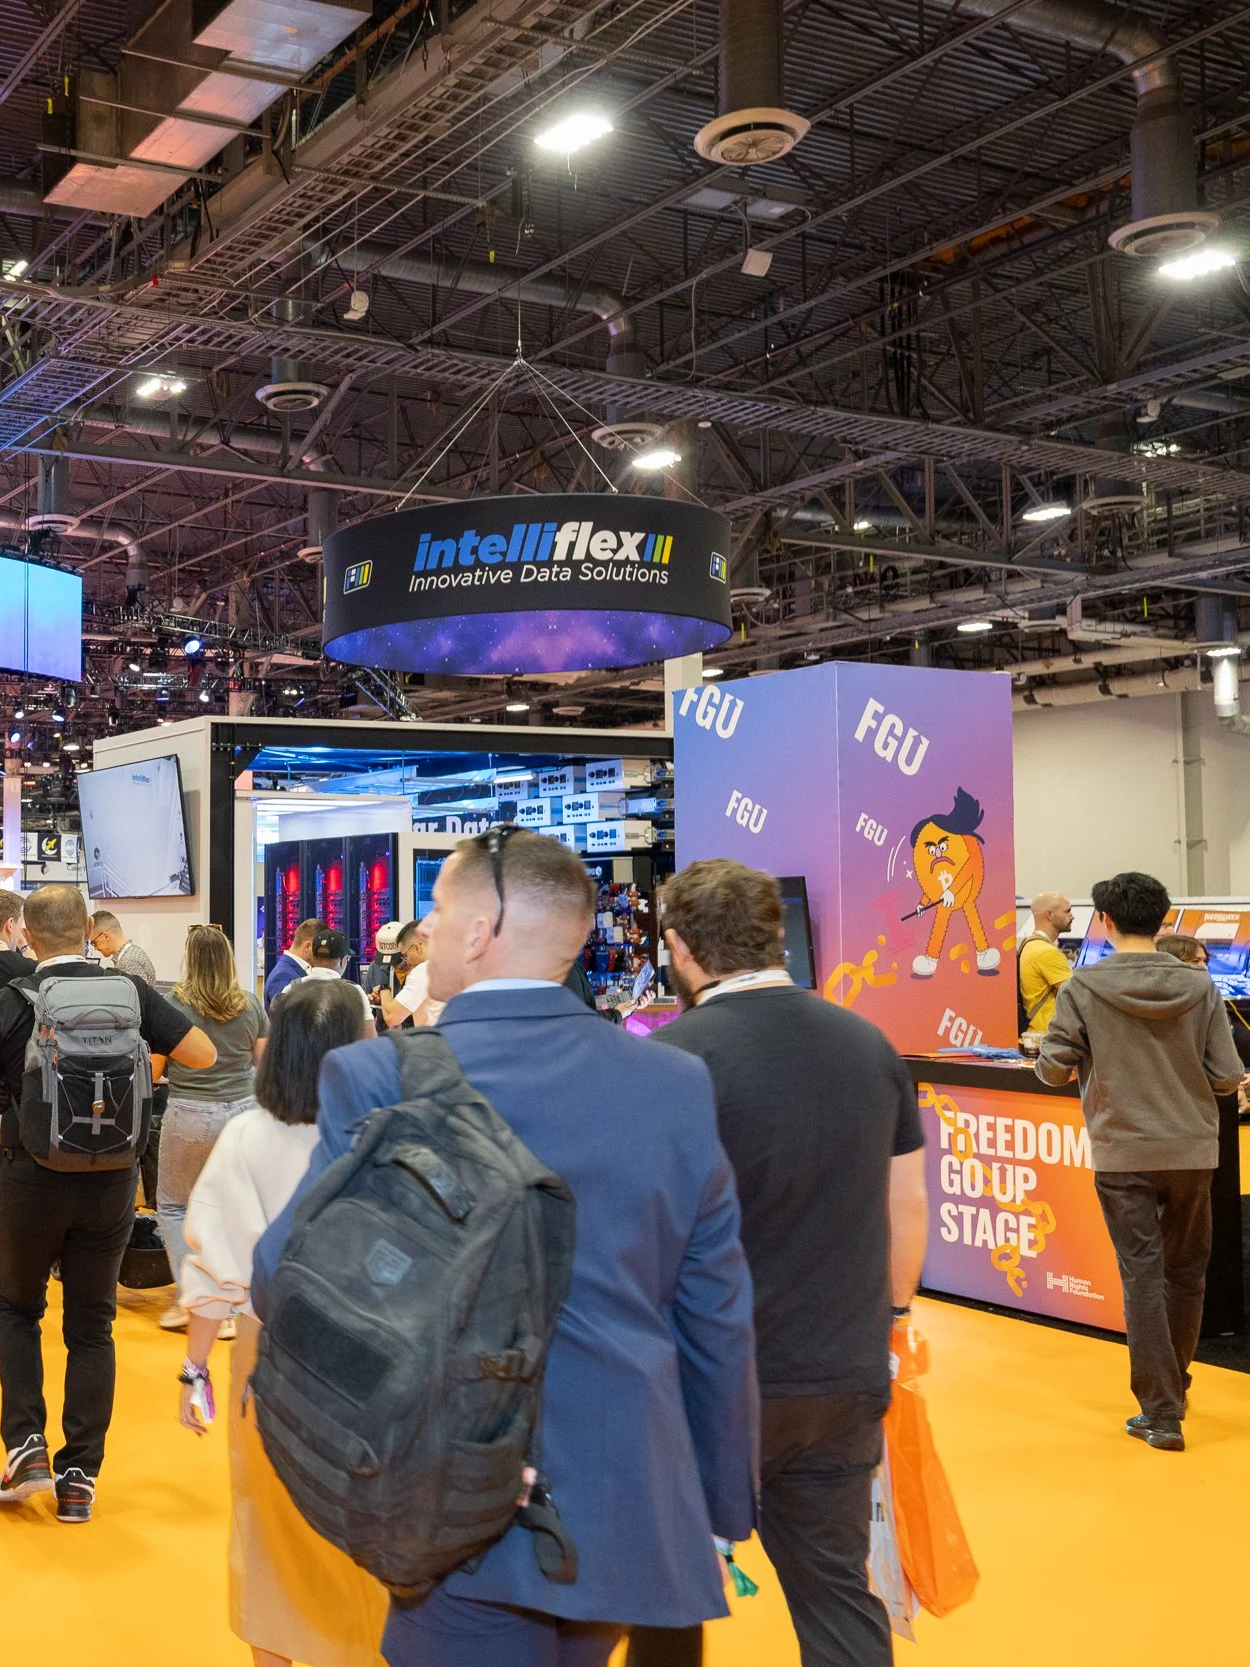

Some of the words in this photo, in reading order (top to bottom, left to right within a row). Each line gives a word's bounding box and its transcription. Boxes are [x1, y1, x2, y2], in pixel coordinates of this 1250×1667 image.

[413, 521, 646, 572] intelliflex
[409, 567, 512, 593] Innovative
[520, 564, 572, 583] Data
[579, 561, 669, 585] Solutions
[678, 684, 745, 739] FGU
[854, 697, 930, 776] FGU
[725, 789, 768, 834] FGU
[855, 812, 888, 847] FGU
[81, 1036, 112, 1045] TITAN
[939, 1110, 1094, 1170] FREEDOM
[940, 1154, 984, 1199] GO
[992, 1162, 1038, 1205] UP
[939, 1202, 1038, 1259] STAGE
[1069, 1275, 1091, 1286] Human
[1069, 1282, 1089, 1291] Rights
[1069, 1289, 1105, 1300] Foundation
